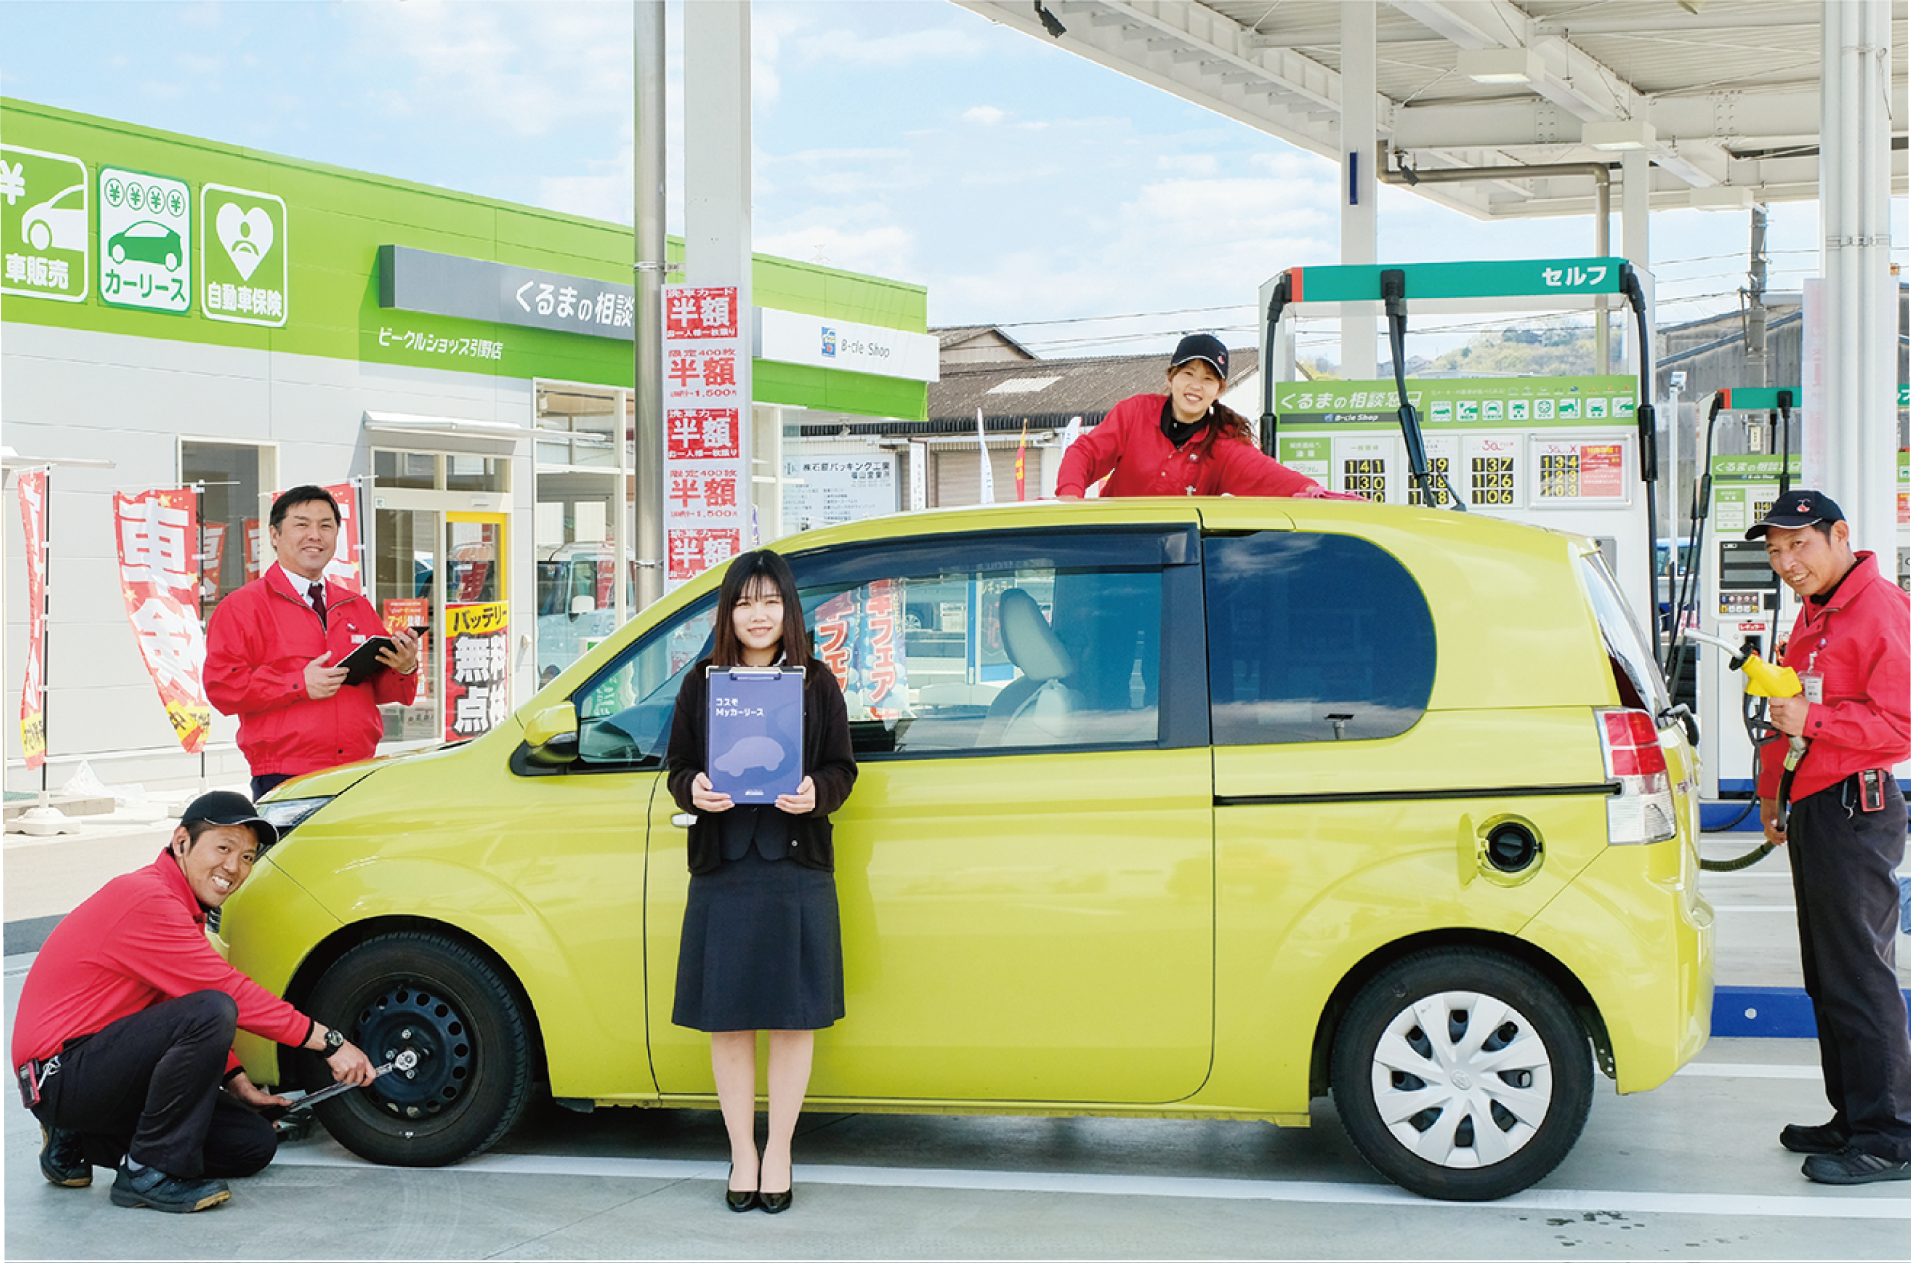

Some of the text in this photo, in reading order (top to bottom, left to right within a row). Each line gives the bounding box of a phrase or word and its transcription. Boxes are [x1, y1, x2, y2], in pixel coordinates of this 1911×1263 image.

[5, 252, 70, 290] 車販売
[1541, 265, 1608, 287] セルフ
[104, 268, 187, 303] カーリース
[207, 281, 283, 318] 自動車保険
[515, 280, 635, 328] くるまの相談
[670, 297, 730, 328] 半額
[868, 342, 890, 359] Shop
[668, 357, 737, 387] 半額
[671, 417, 732, 448] 半額
[1348, 461, 1382, 473] 141
[1475, 458, 1512, 472] 137
[1544, 455, 1578, 469] 134
[1715, 461, 1801, 473] くるまの相談口
[1348, 476, 1384, 489] 130
[1475, 474, 1512, 488] 126
[1544, 470, 1577, 483] 123
[669, 478, 738, 507] 半額
[1475, 490, 1512, 504] 106
[1544, 484, 1577, 497] 103
[672, 538, 732, 569] 半額
[715, 698, 739, 707] コスモ
[715, 708, 764, 717] Myカーリース
